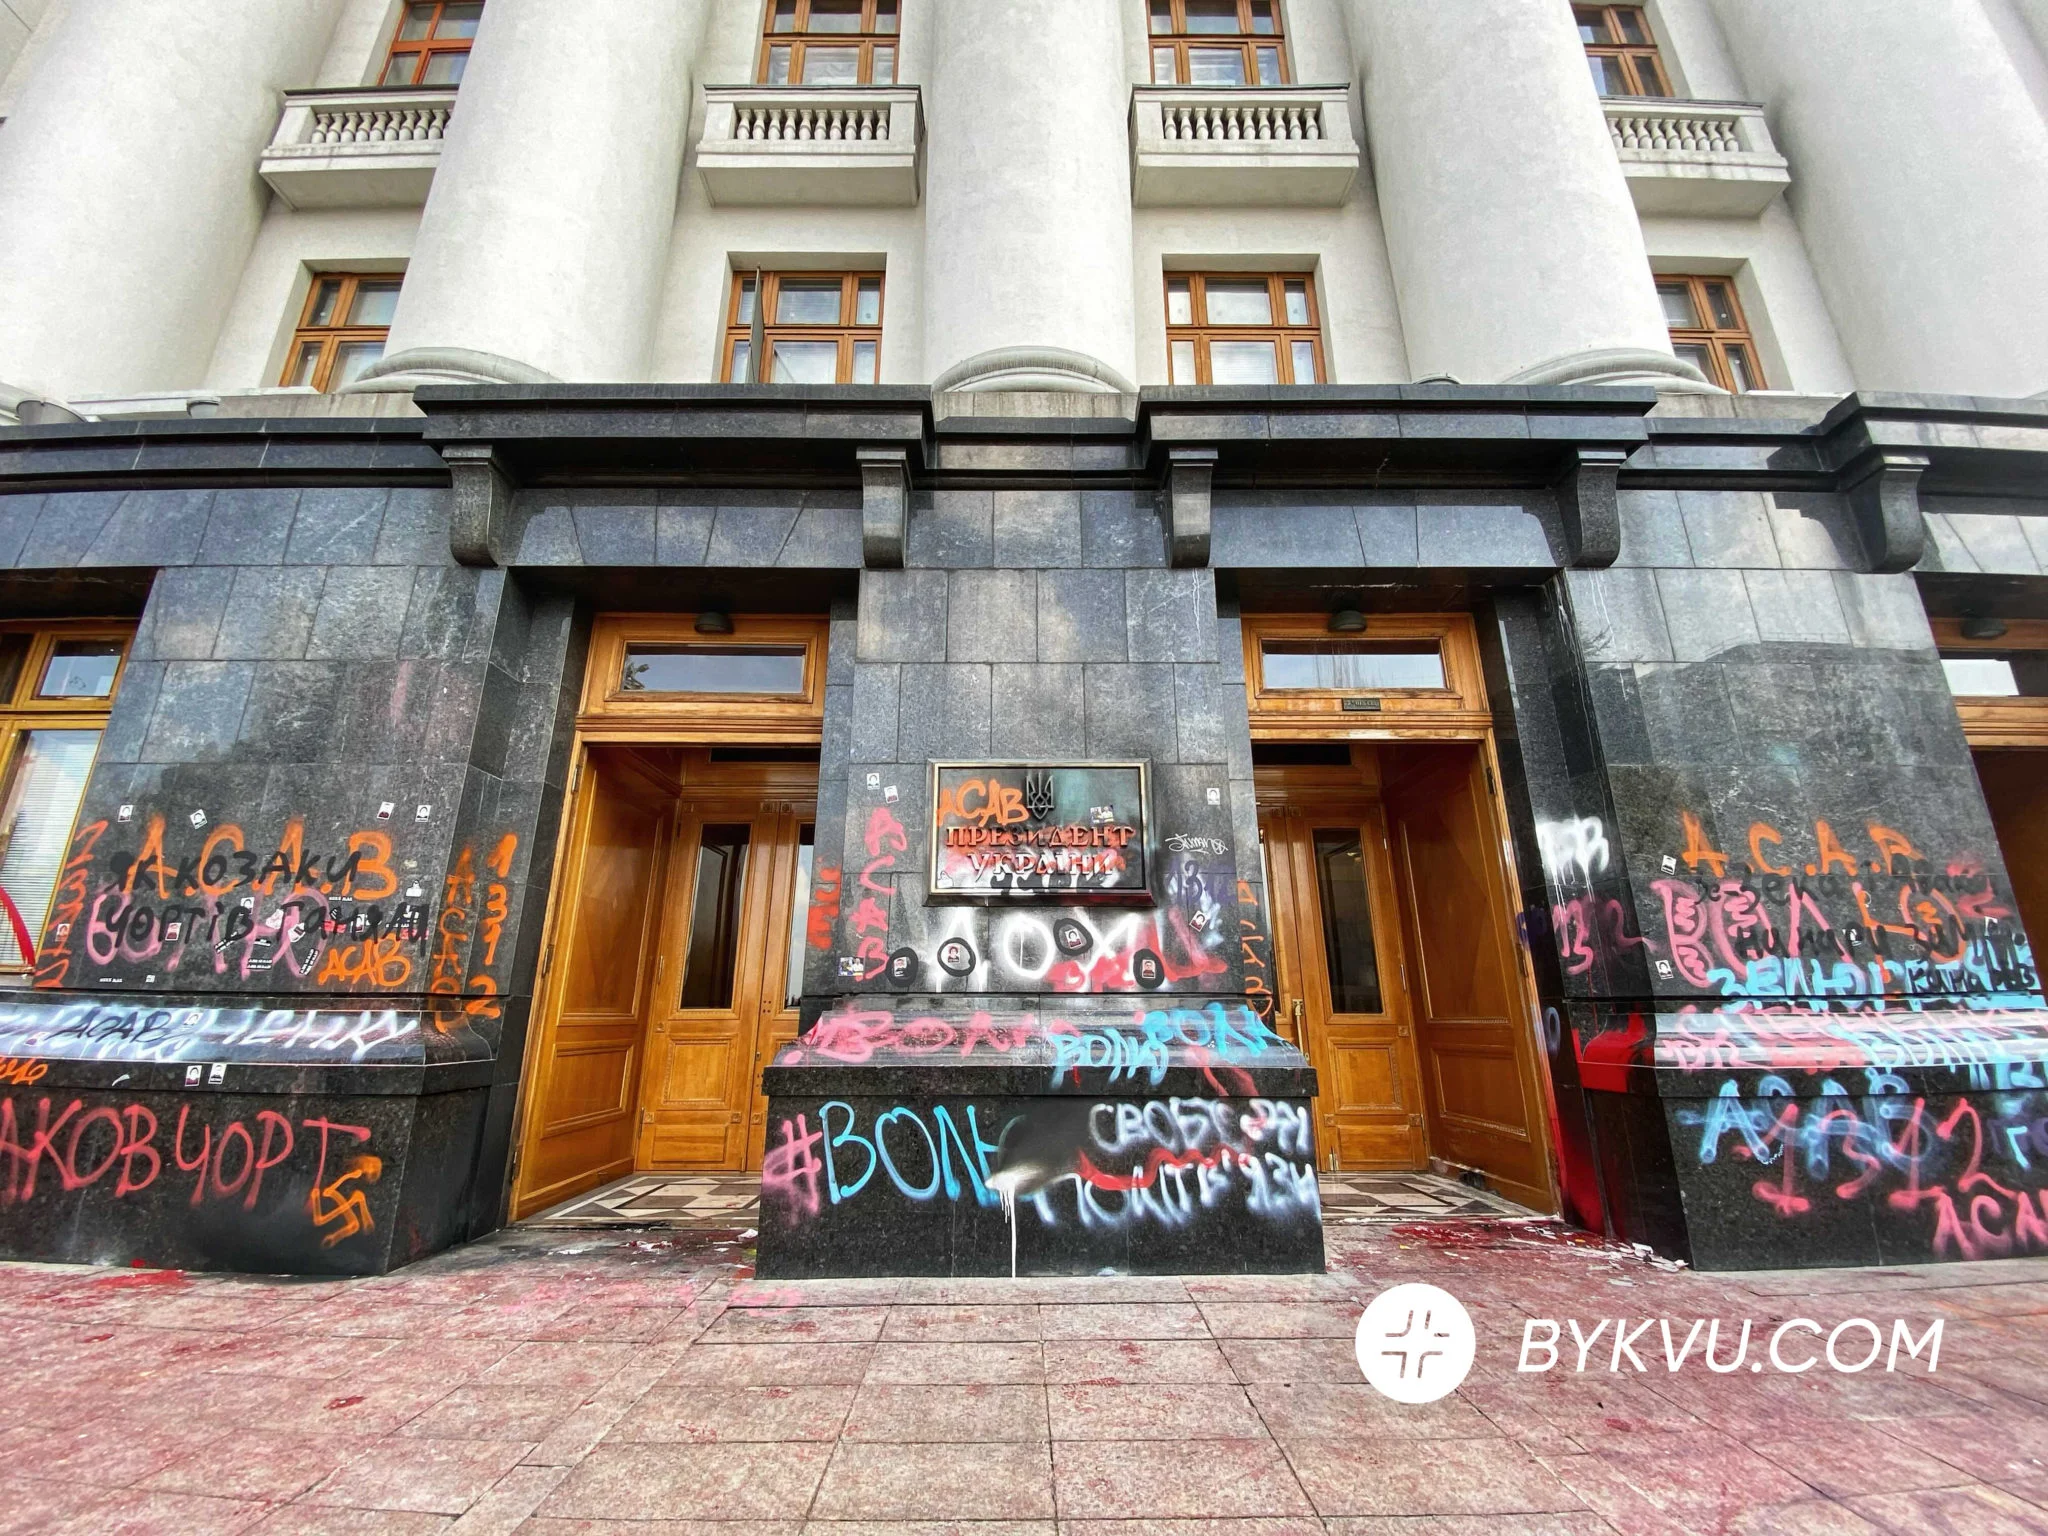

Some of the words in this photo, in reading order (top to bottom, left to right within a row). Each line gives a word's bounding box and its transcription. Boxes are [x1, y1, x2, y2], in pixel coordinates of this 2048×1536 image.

[946, 826, 1137, 847] ПРЕЗИДЕНТ
[175, 849, 362, 891] КОЗАКИ
[464, 831, 517, 1020] 1312
[1931, 1190, 2048, 1262] ACA
